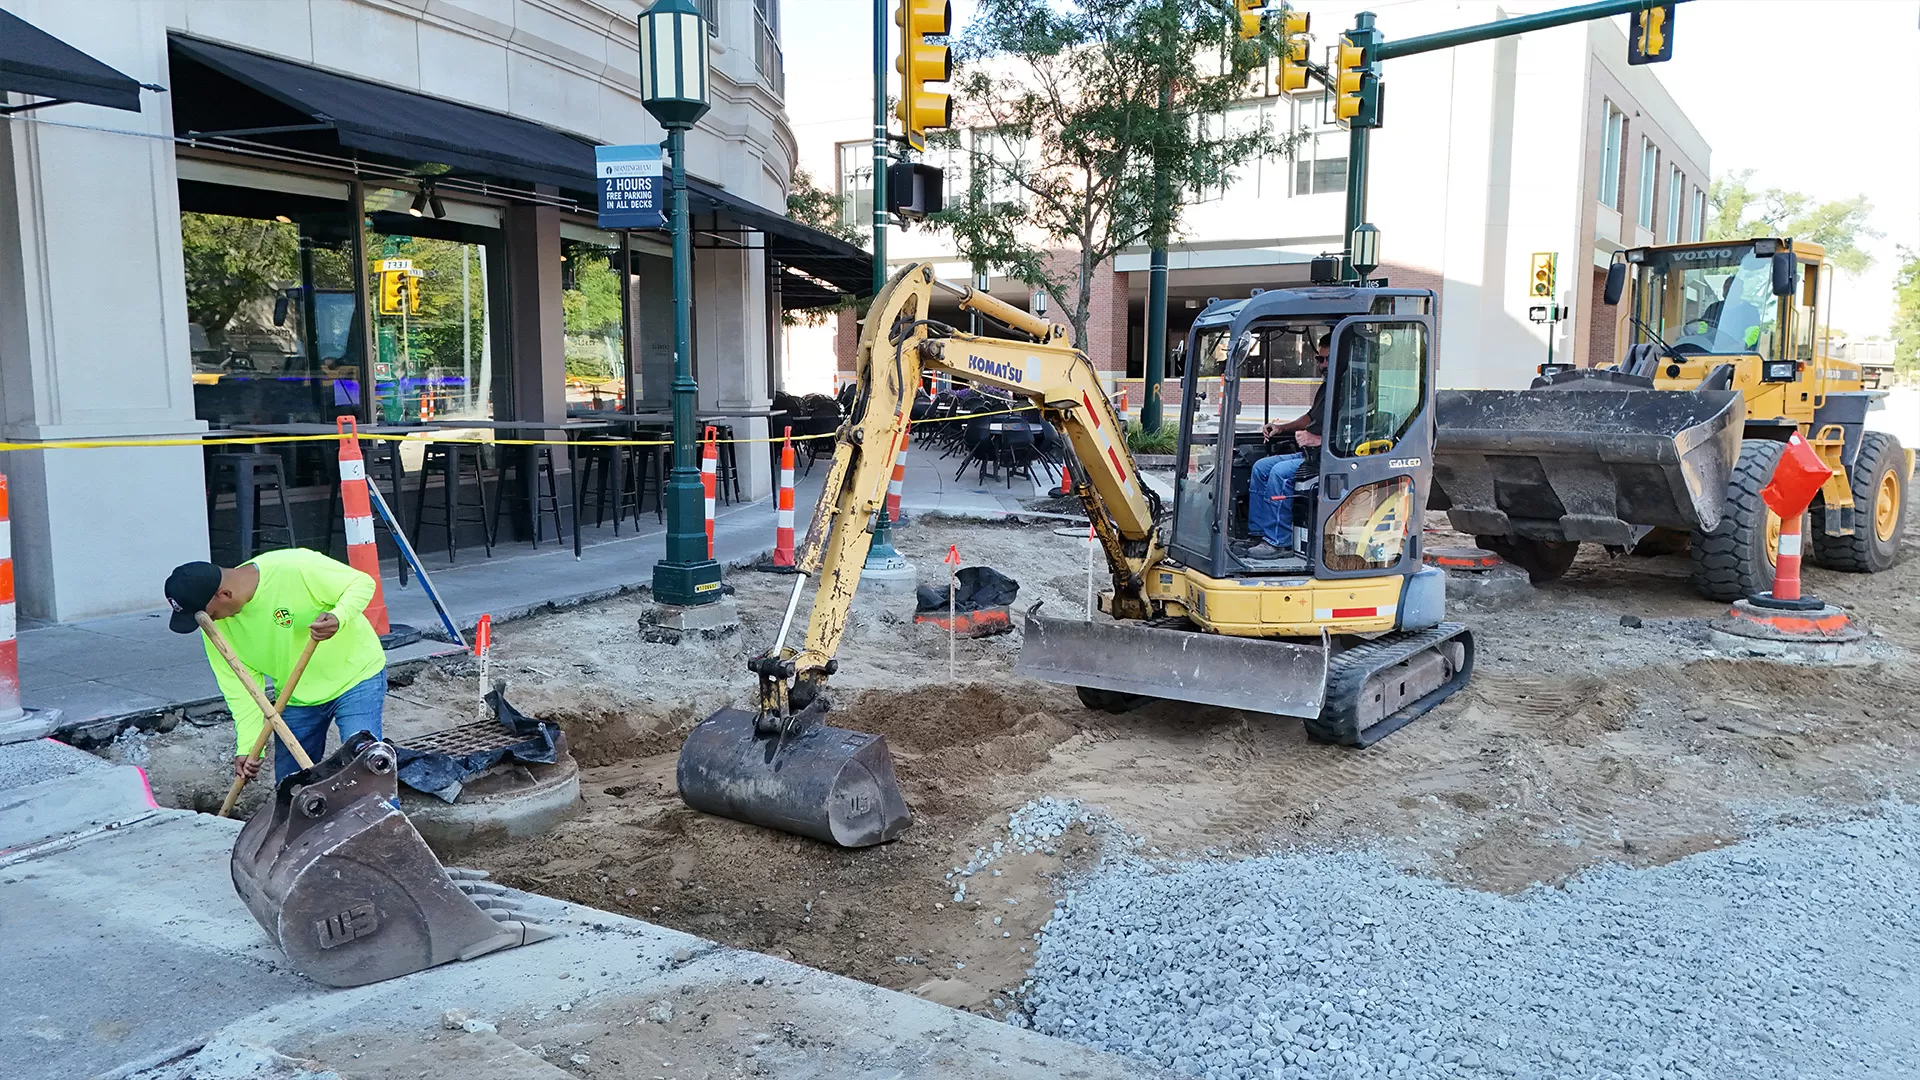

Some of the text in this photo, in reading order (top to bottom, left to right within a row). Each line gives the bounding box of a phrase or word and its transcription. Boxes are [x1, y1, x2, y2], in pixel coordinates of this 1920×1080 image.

[606, 178, 652, 191] 2 HOURS
[606, 190, 652, 200] FREE PARKING
[606, 201, 614, 209] IN
[630, 199, 653, 208] DECKS
[1672, 249, 1732, 260] VOLVO
[968, 354, 1022, 383] KOMATSU
[1388, 457, 1421, 469] GALEO
